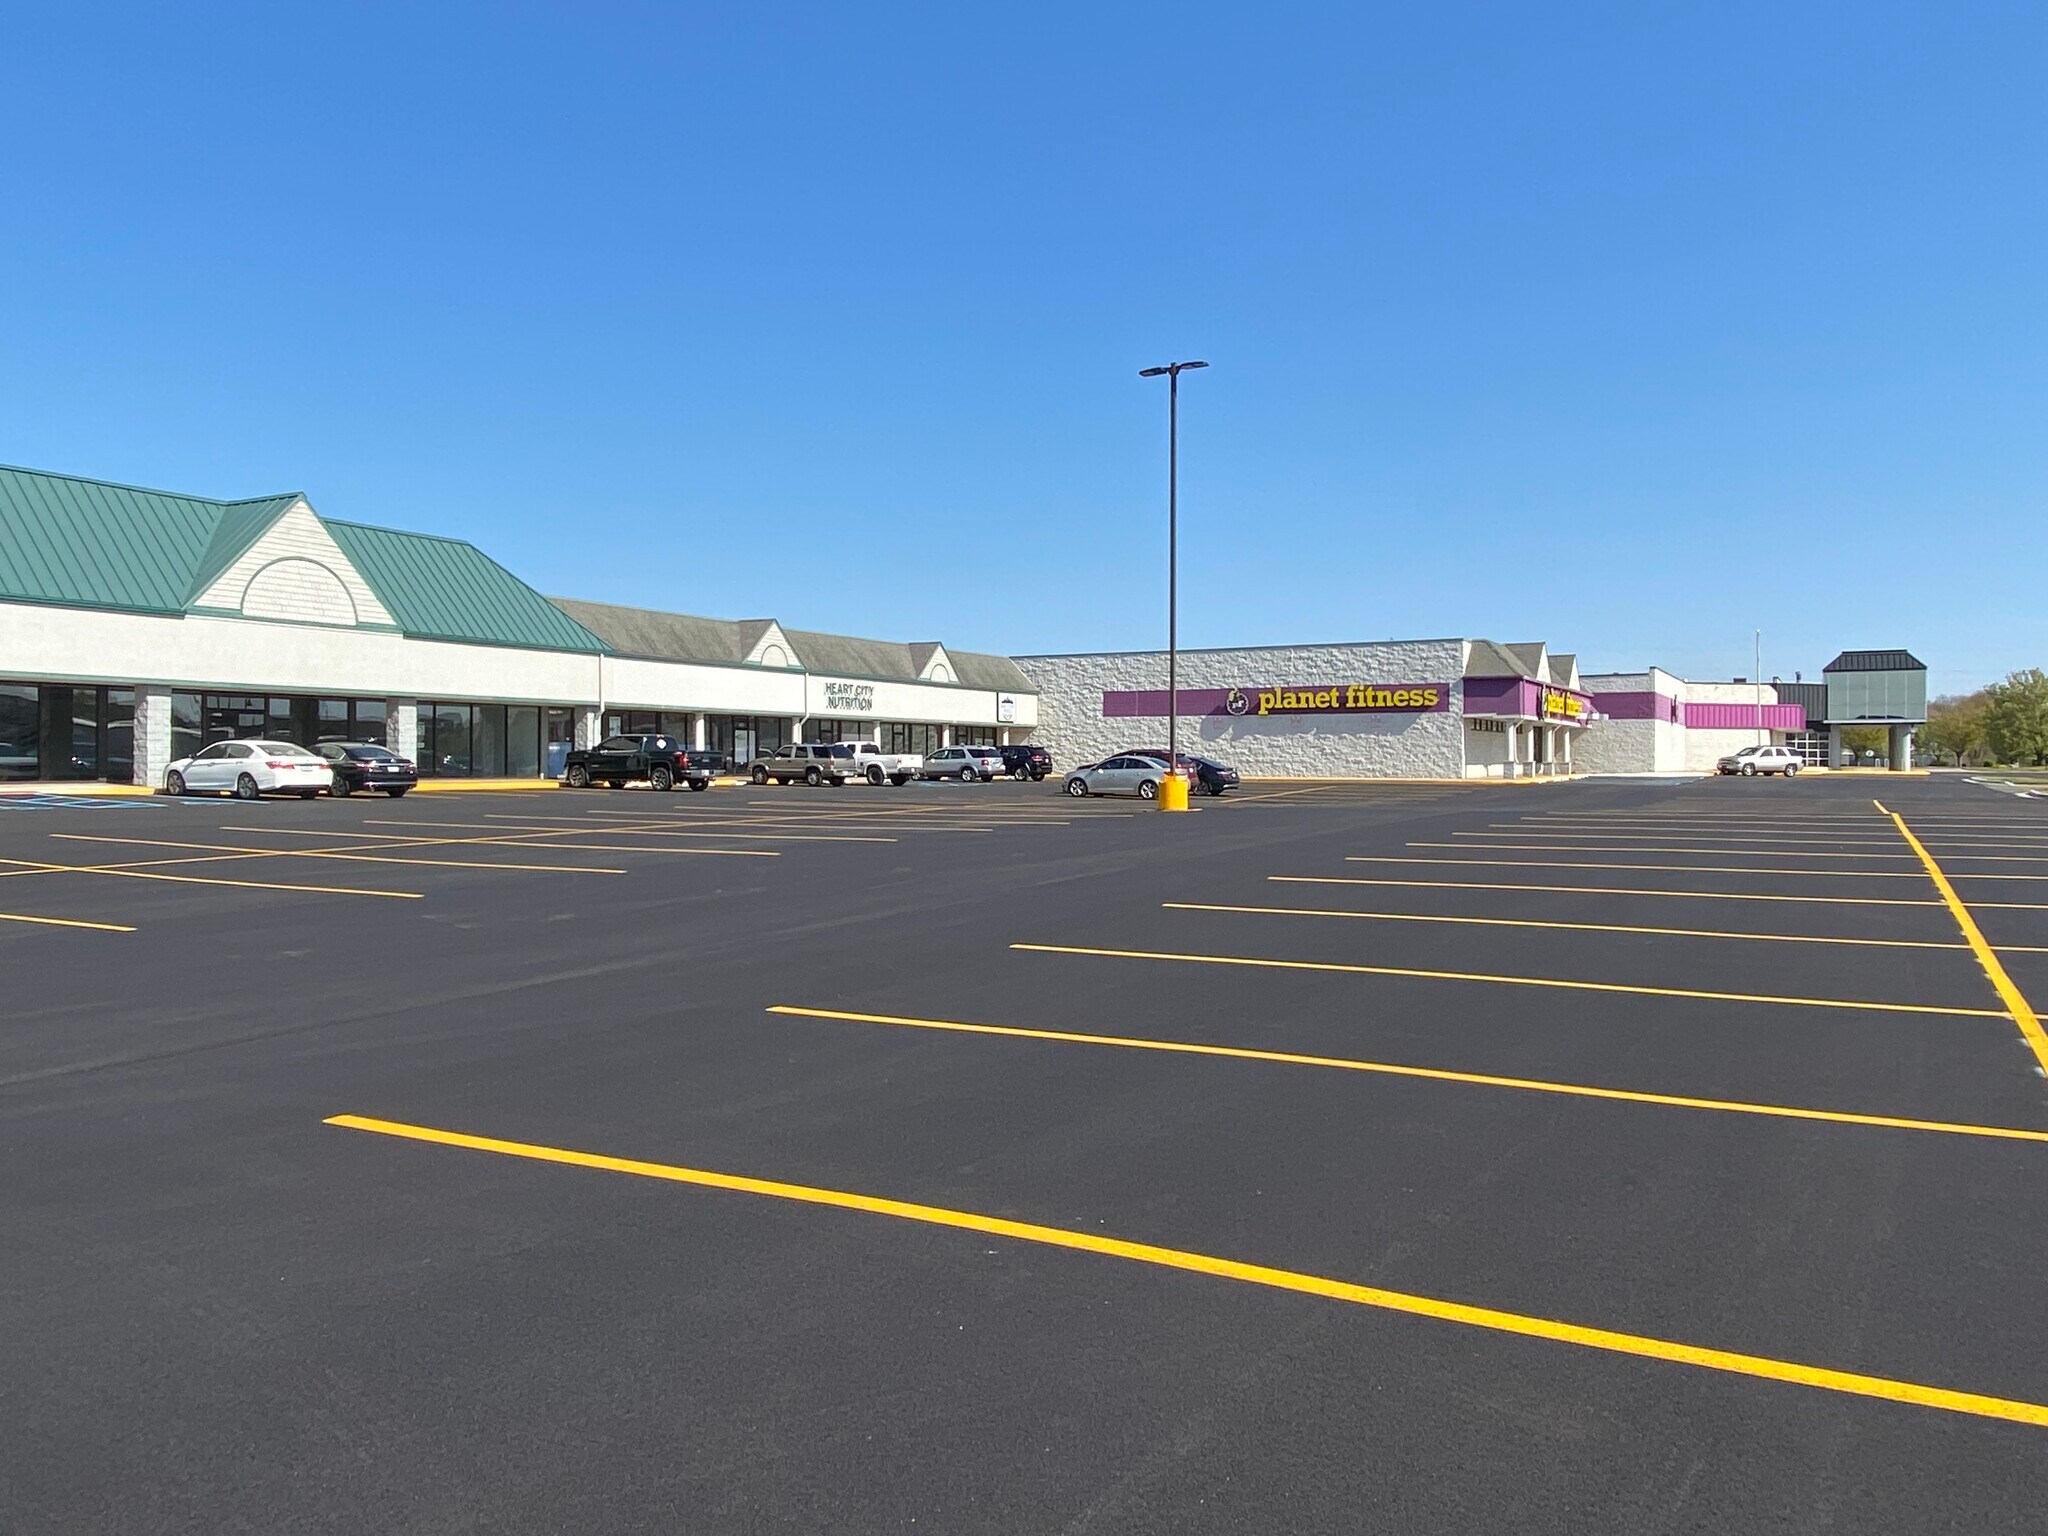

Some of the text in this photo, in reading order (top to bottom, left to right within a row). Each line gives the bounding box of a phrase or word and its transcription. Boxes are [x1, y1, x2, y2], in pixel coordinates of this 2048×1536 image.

[825, 682, 874, 697] HEART CITY
[827, 696, 873, 710] NUTRITION
[1258, 683, 1439, 715] planet fitness
